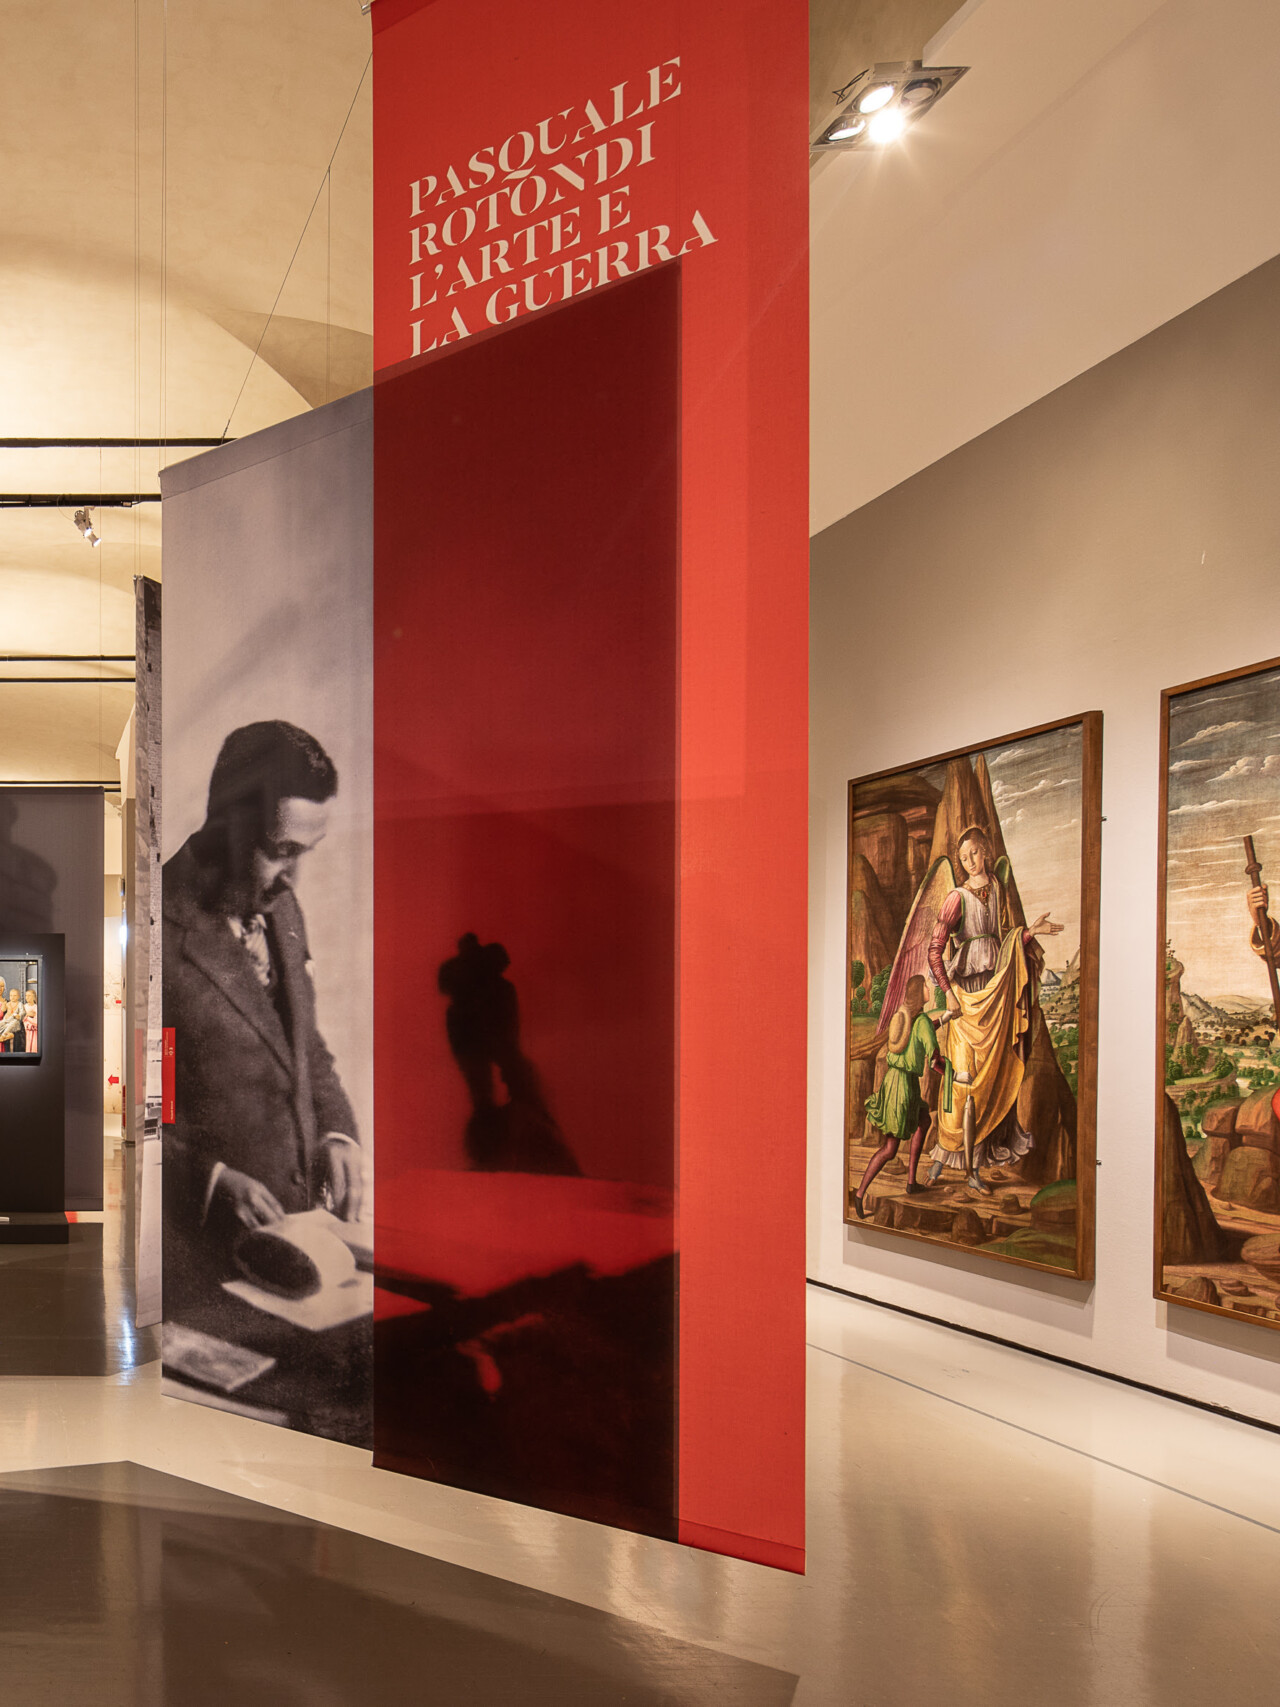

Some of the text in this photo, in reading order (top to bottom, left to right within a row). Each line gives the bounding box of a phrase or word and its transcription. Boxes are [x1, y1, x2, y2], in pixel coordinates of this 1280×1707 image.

[409, 56, 681, 218] PASQUALE
[409, 120, 656, 265] ROTONDI
[409, 185, 631, 312] L’ARTE E
[409, 209, 719, 358] LA GUERRA
